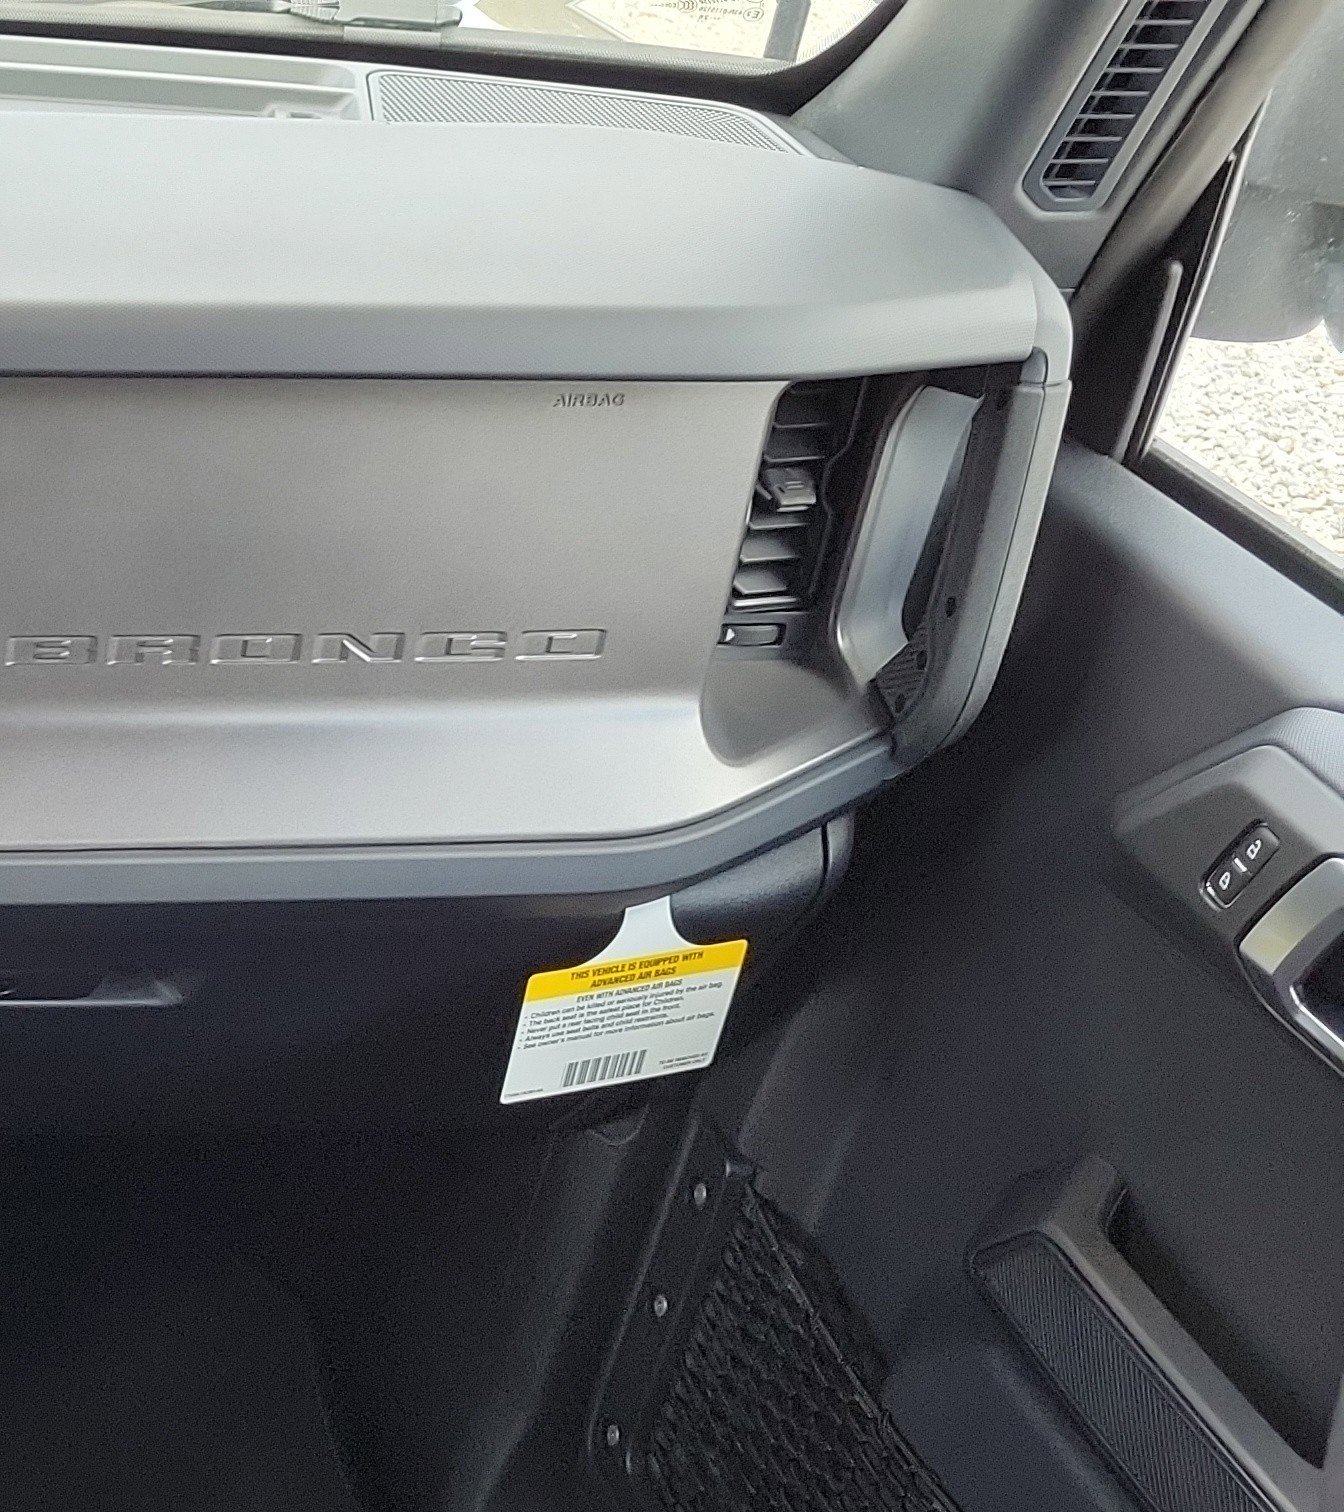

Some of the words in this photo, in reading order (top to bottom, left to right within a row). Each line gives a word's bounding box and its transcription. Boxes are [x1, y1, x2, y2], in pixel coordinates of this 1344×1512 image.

[552, 392, 625, 409] AIRBAG
[4, 627, 607, 667] BRONCO
[570, 969, 590, 980] THIS
[591, 963, 626, 976] VEHICLE
[627, 961, 637, 970] IS
[638, 954, 680, 968] EQUIPPED
[681, 951, 704, 961] WITH
[590, 972, 636, 987] ADVANCED
[636, 969, 652, 980] AIR
[653, 965, 677, 977] BAGS
[576, 993, 594, 1002] EVEN
[595, 990, 614, 999] WITH
[614, 984, 650, 996] ADVANCED
[650, 982, 663, 990] AIR
[664, 978, 683, 987] BAGS
